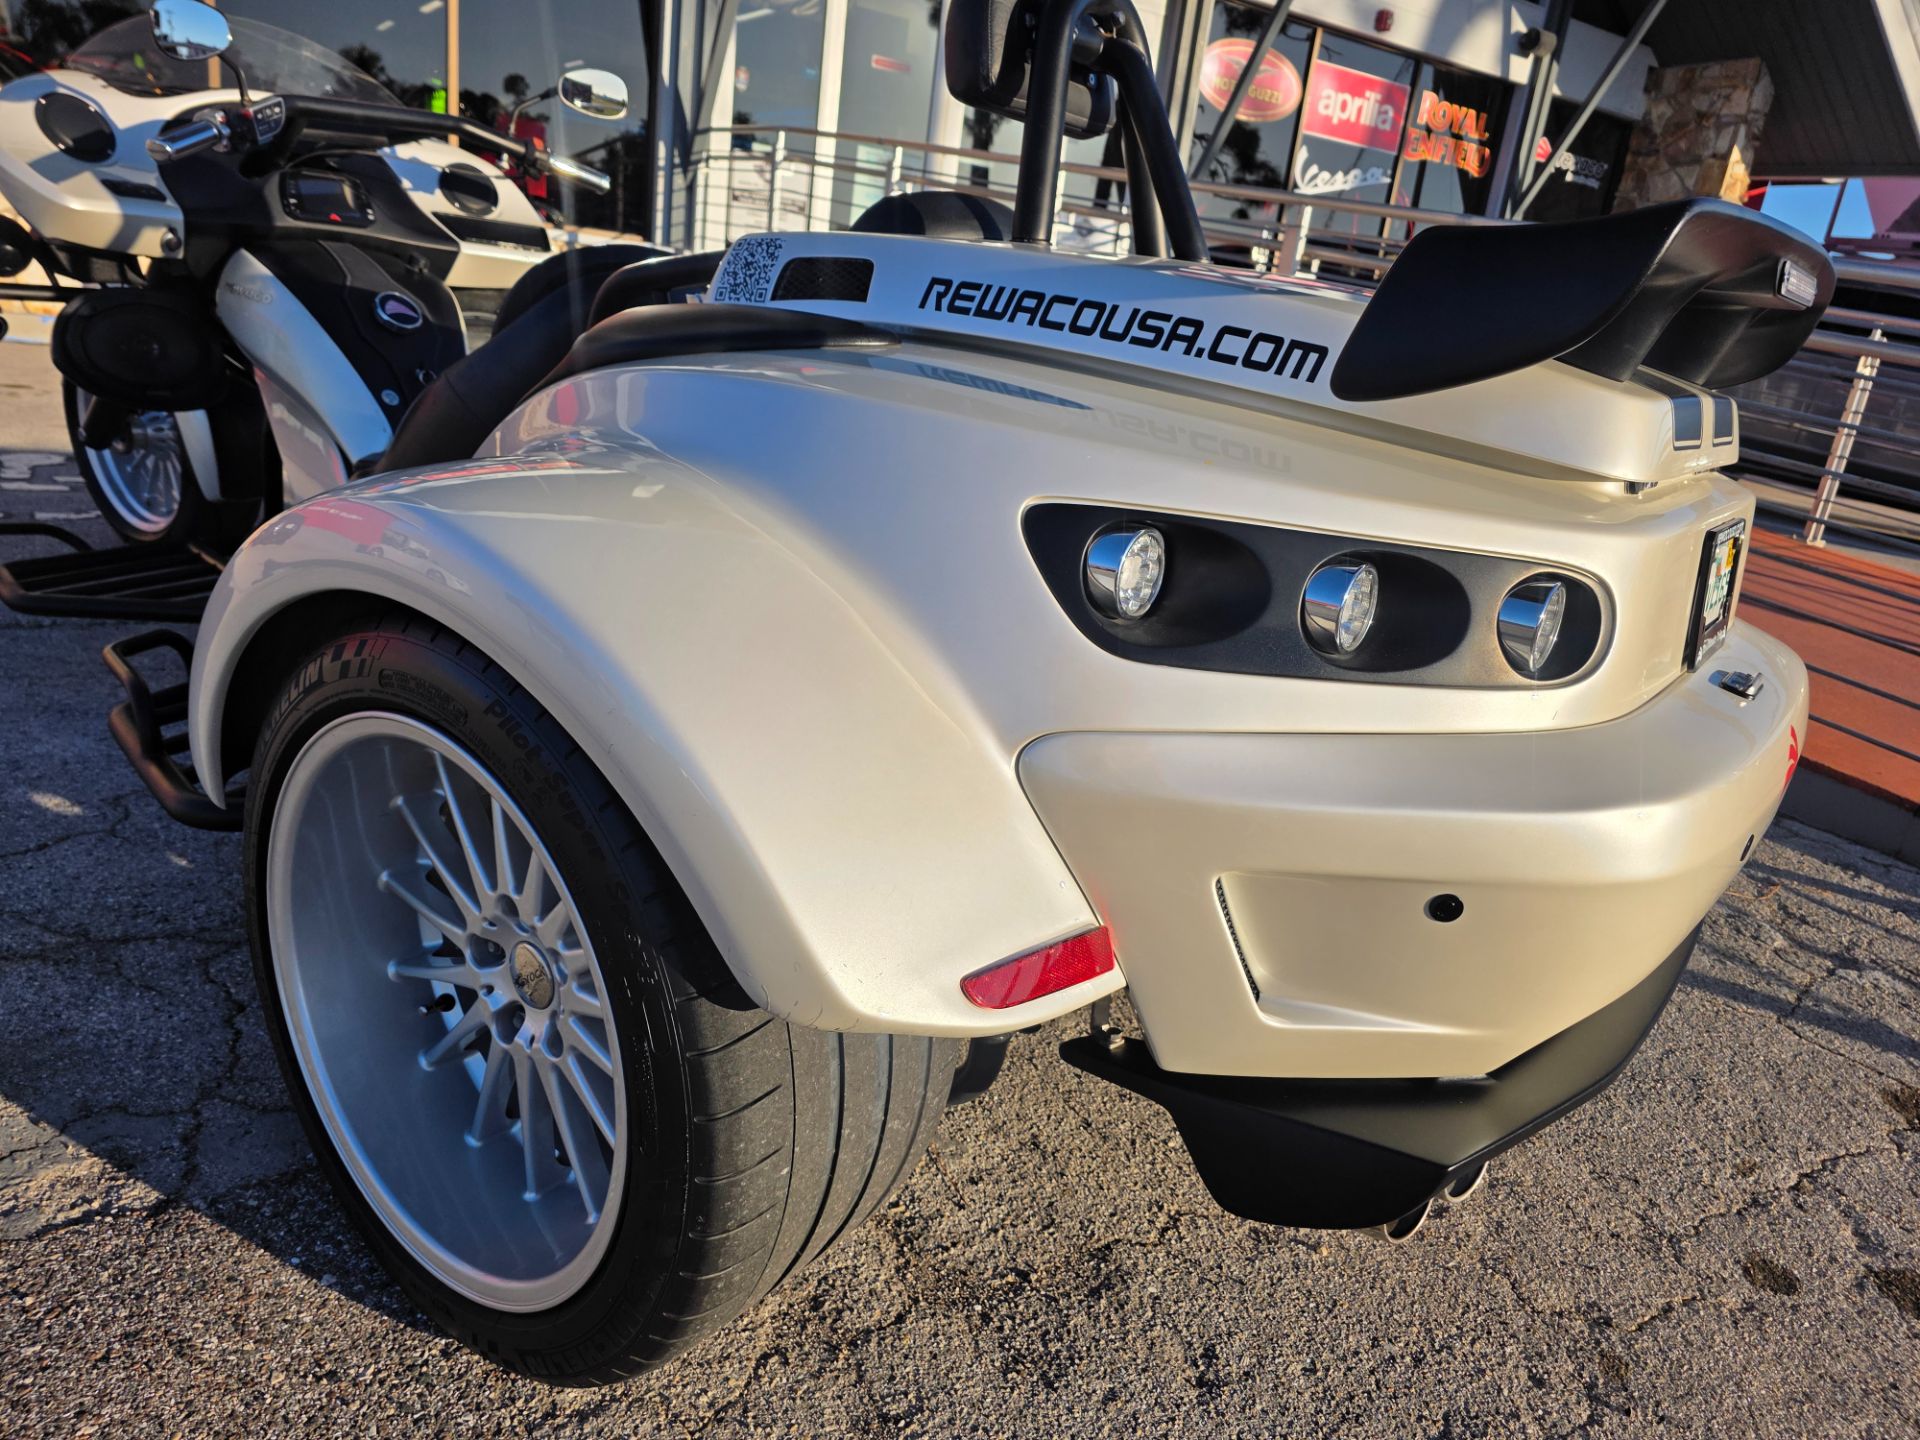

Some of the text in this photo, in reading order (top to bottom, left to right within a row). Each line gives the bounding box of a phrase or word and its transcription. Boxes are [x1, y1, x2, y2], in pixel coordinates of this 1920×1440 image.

[1247, 84, 1282, 105] GUZZI
[1317, 88, 1395, 132] aprilia
[1417, 89, 1489, 141] ROYAL
[1294, 144, 1391, 195] Vespa
[1402, 128, 1491, 178] ENFIELD
[918, 276, 1330, 383] REWACOUSA.COM
